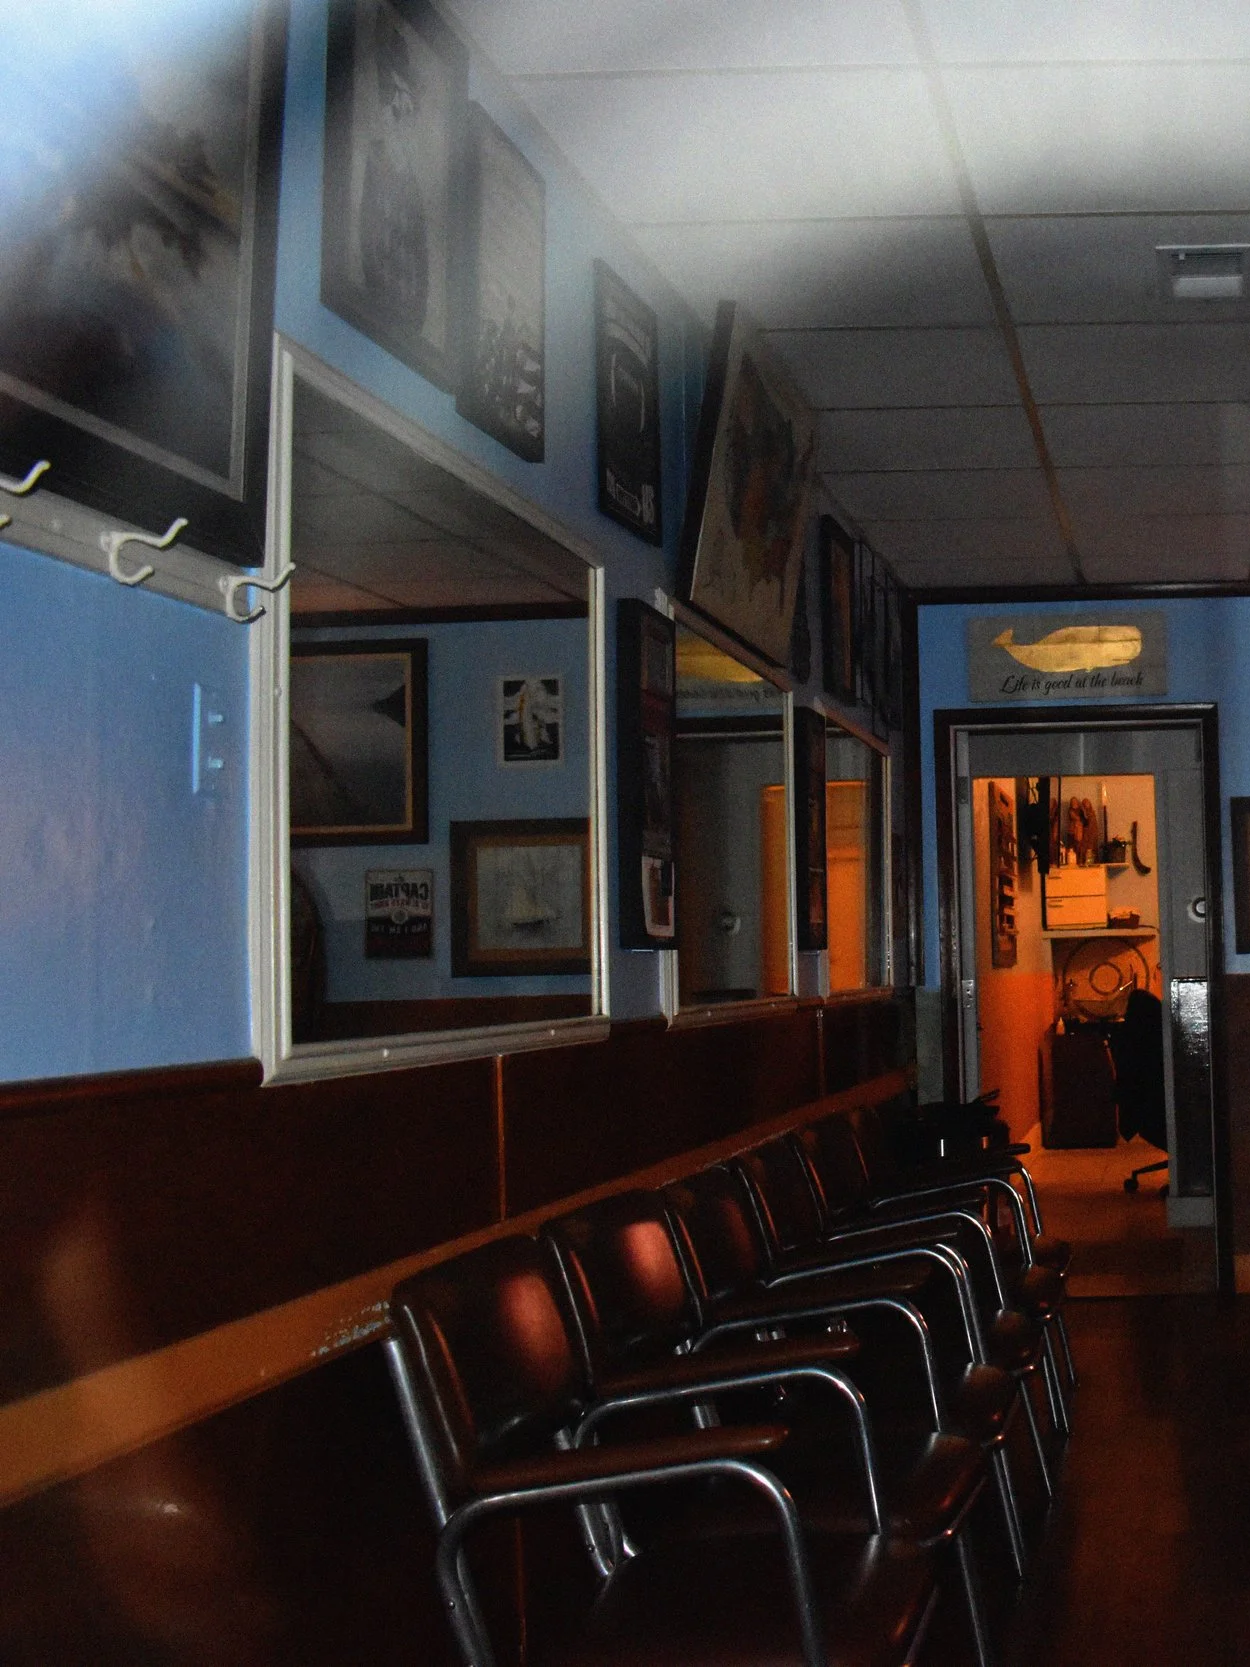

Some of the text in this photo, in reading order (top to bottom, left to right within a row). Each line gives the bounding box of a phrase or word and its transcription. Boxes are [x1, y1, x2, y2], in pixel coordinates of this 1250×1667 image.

[999, 671, 1144, 695] Life is good at the beach
